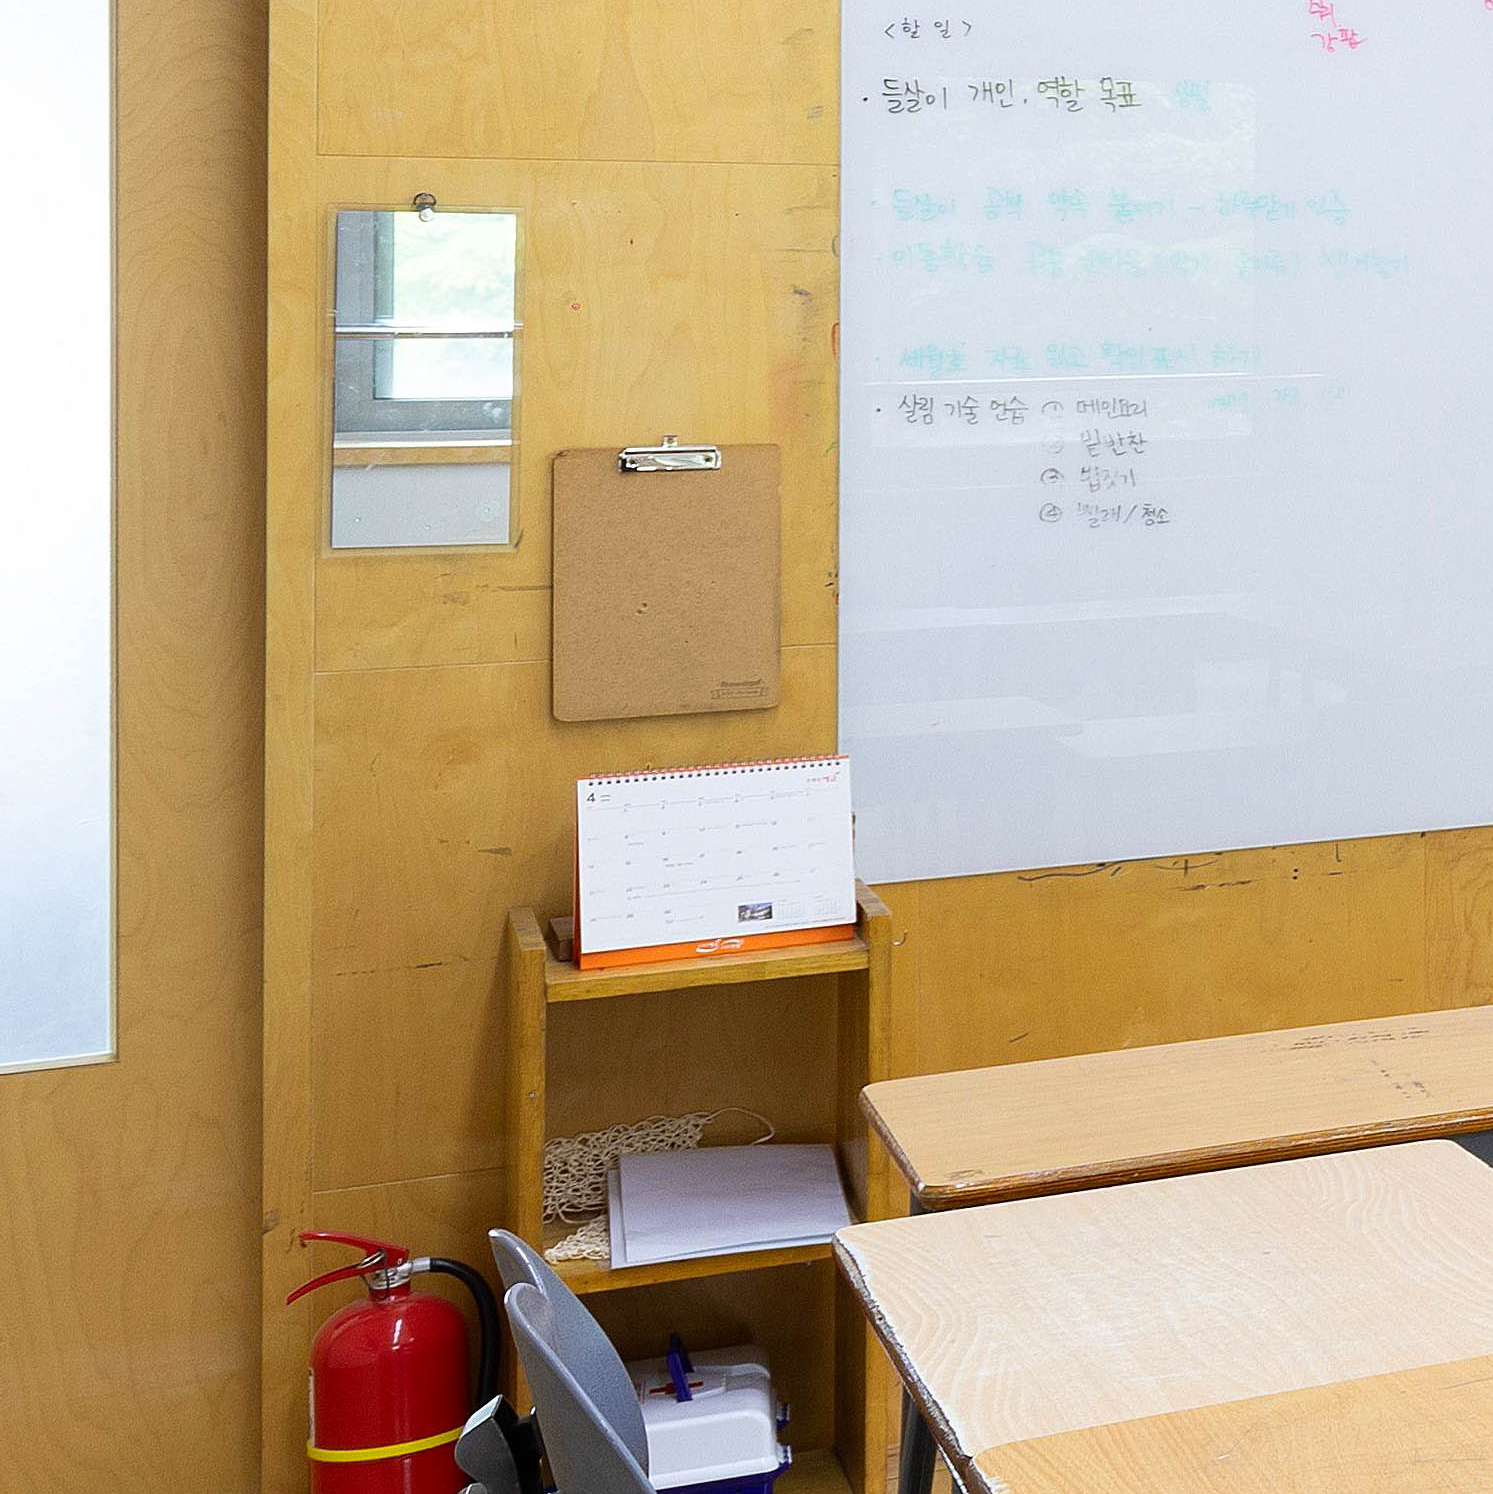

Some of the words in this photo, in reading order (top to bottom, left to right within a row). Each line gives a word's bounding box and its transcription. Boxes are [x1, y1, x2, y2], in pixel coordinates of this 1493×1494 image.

[1036, 75, 1086, 113] 역할
[1099, 76, 1142, 113] 목표
[897, 393, 934, 426] 살림
[943, 395, 980, 426] 기술
[989, 395, 1029, 426] 연습
